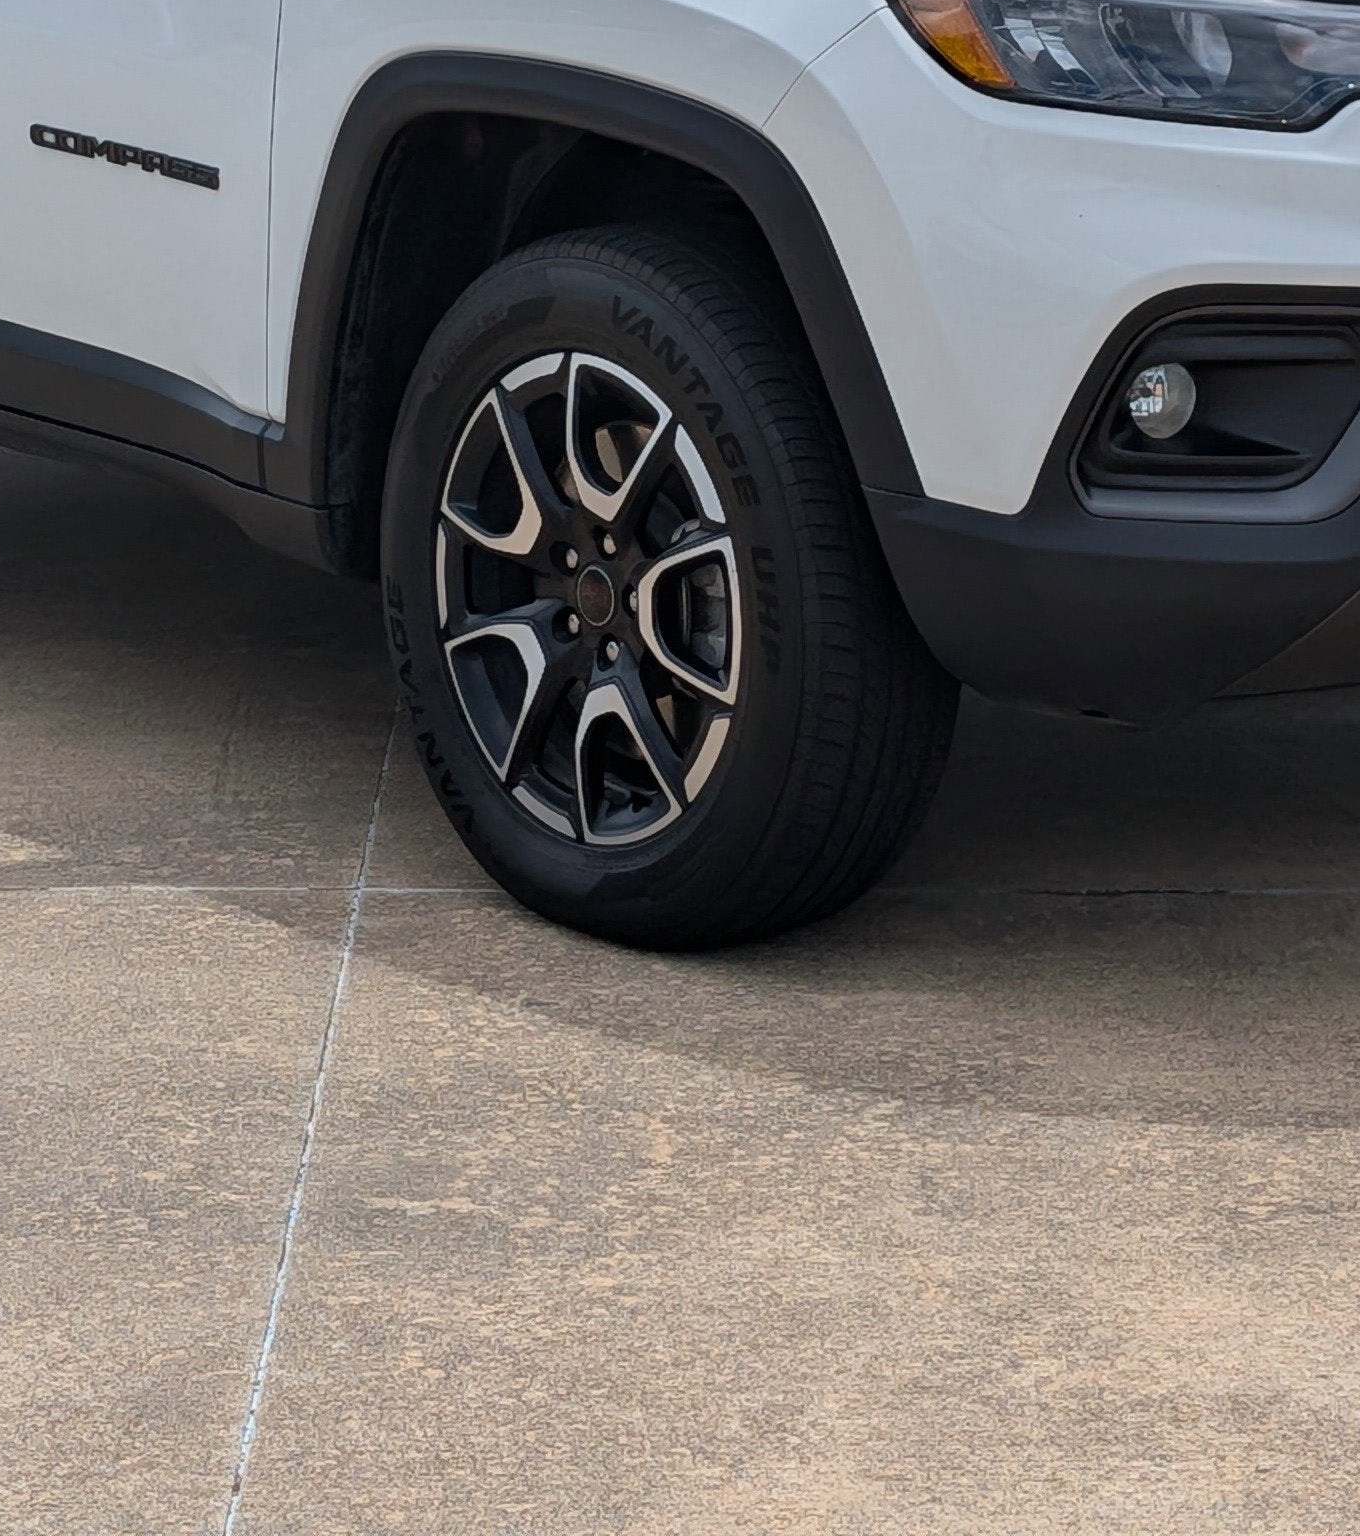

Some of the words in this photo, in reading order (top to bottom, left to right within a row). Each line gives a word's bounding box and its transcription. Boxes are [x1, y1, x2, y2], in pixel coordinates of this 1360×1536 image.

[29, 123, 220, 191] COMPASS
[611, 295, 761, 507] VANTAGE
[750, 545, 783, 674] UHP
